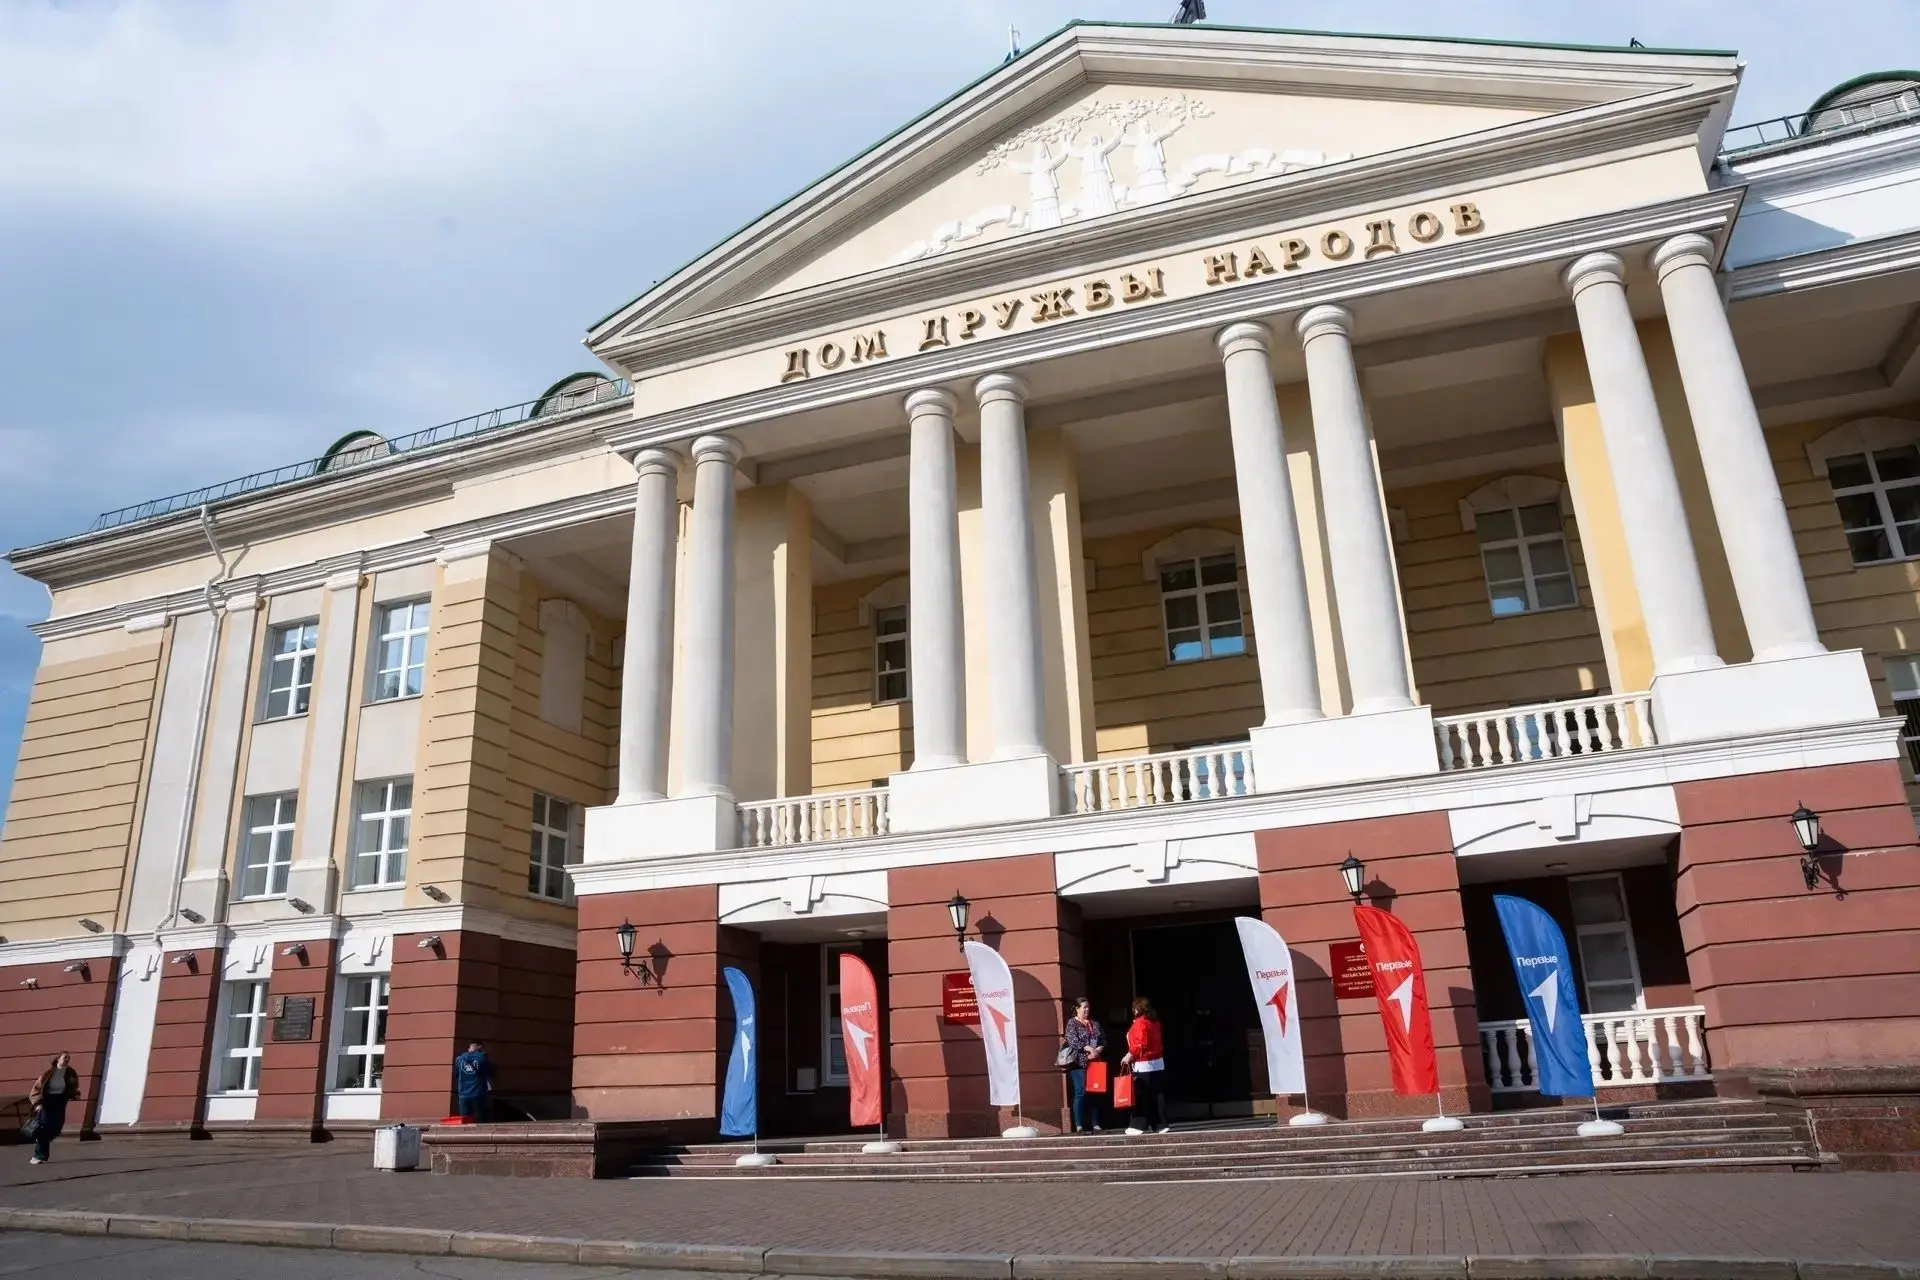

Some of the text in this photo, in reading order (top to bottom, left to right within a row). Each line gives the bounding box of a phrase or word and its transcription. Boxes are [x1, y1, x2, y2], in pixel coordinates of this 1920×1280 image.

[780, 202, 1482, 382] ДОМ ДРУЖБЫ НАРОДОВ
[1376, 960, 1413, 973] Первые
[1516, 955, 1558, 968] Первые
[1255, 969, 1288, 980] Первые
